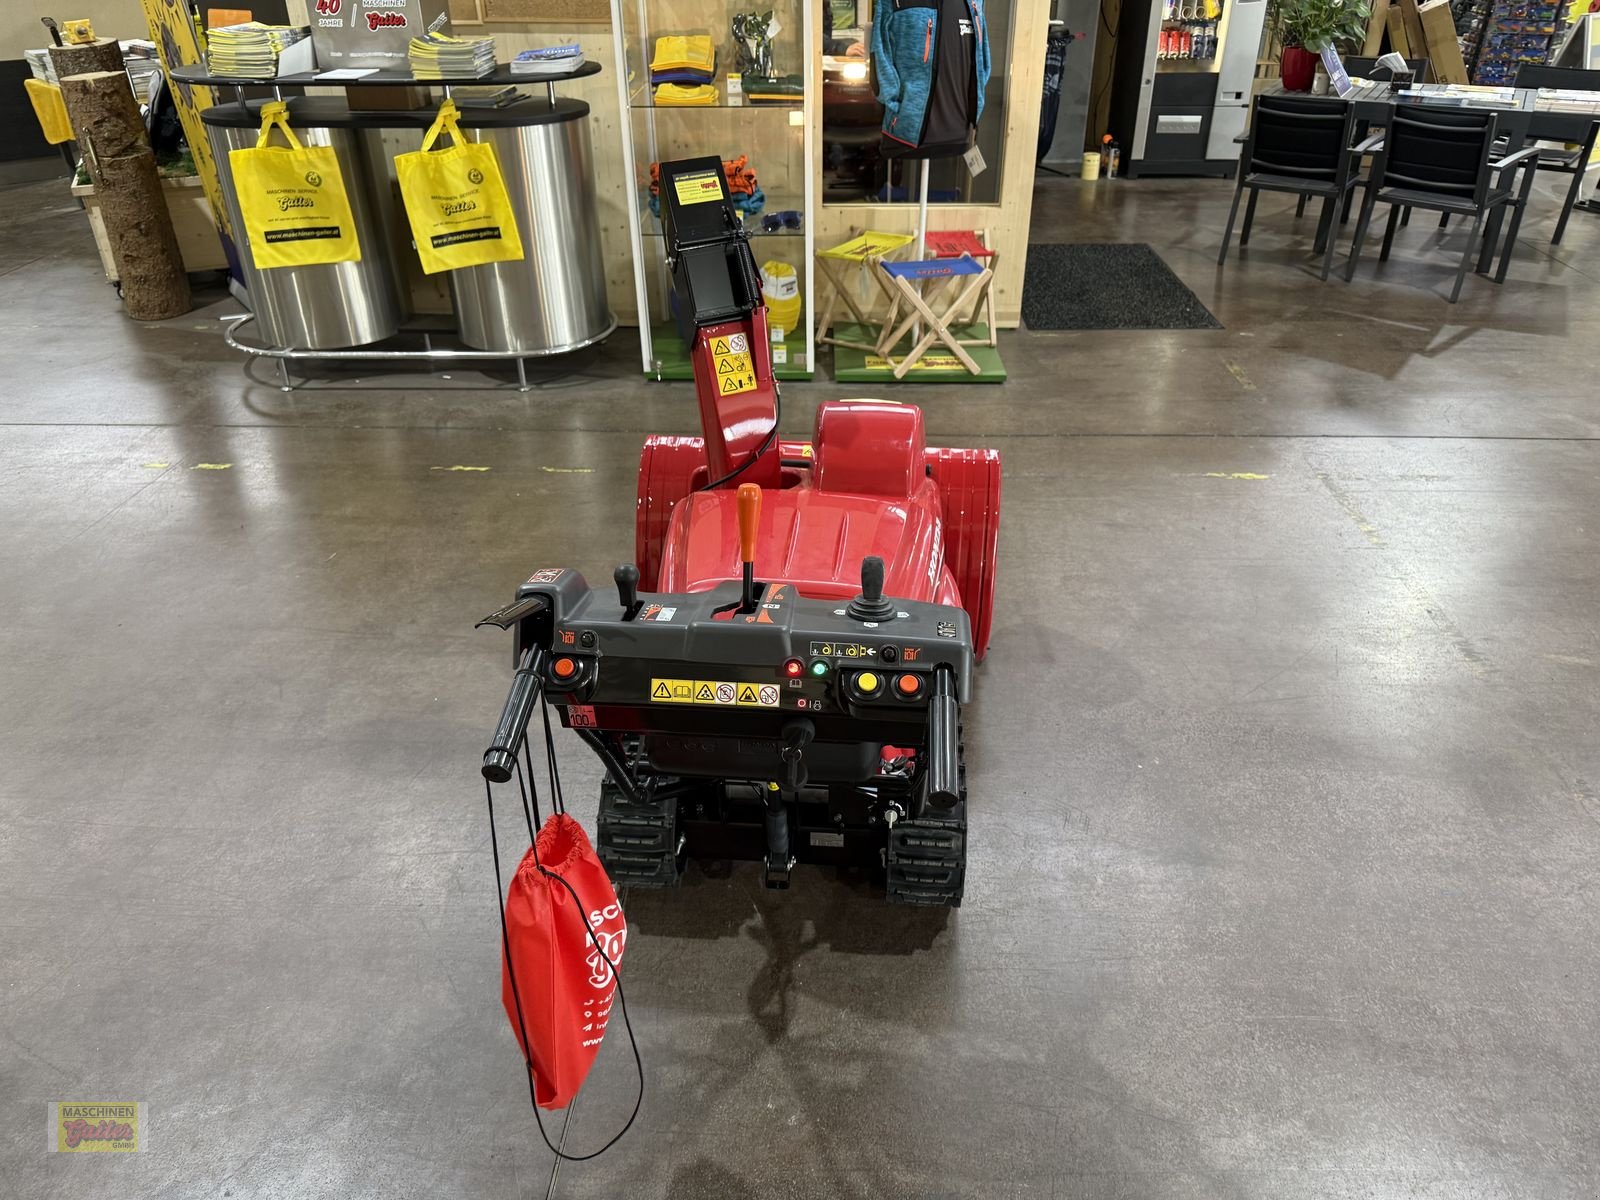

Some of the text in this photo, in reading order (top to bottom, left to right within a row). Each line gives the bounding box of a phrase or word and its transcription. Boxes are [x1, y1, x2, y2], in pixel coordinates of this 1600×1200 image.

[316, 0, 341, 14] 40
[319, 19, 343, 27] JAHRE
[570, 714, 590, 726] 100
